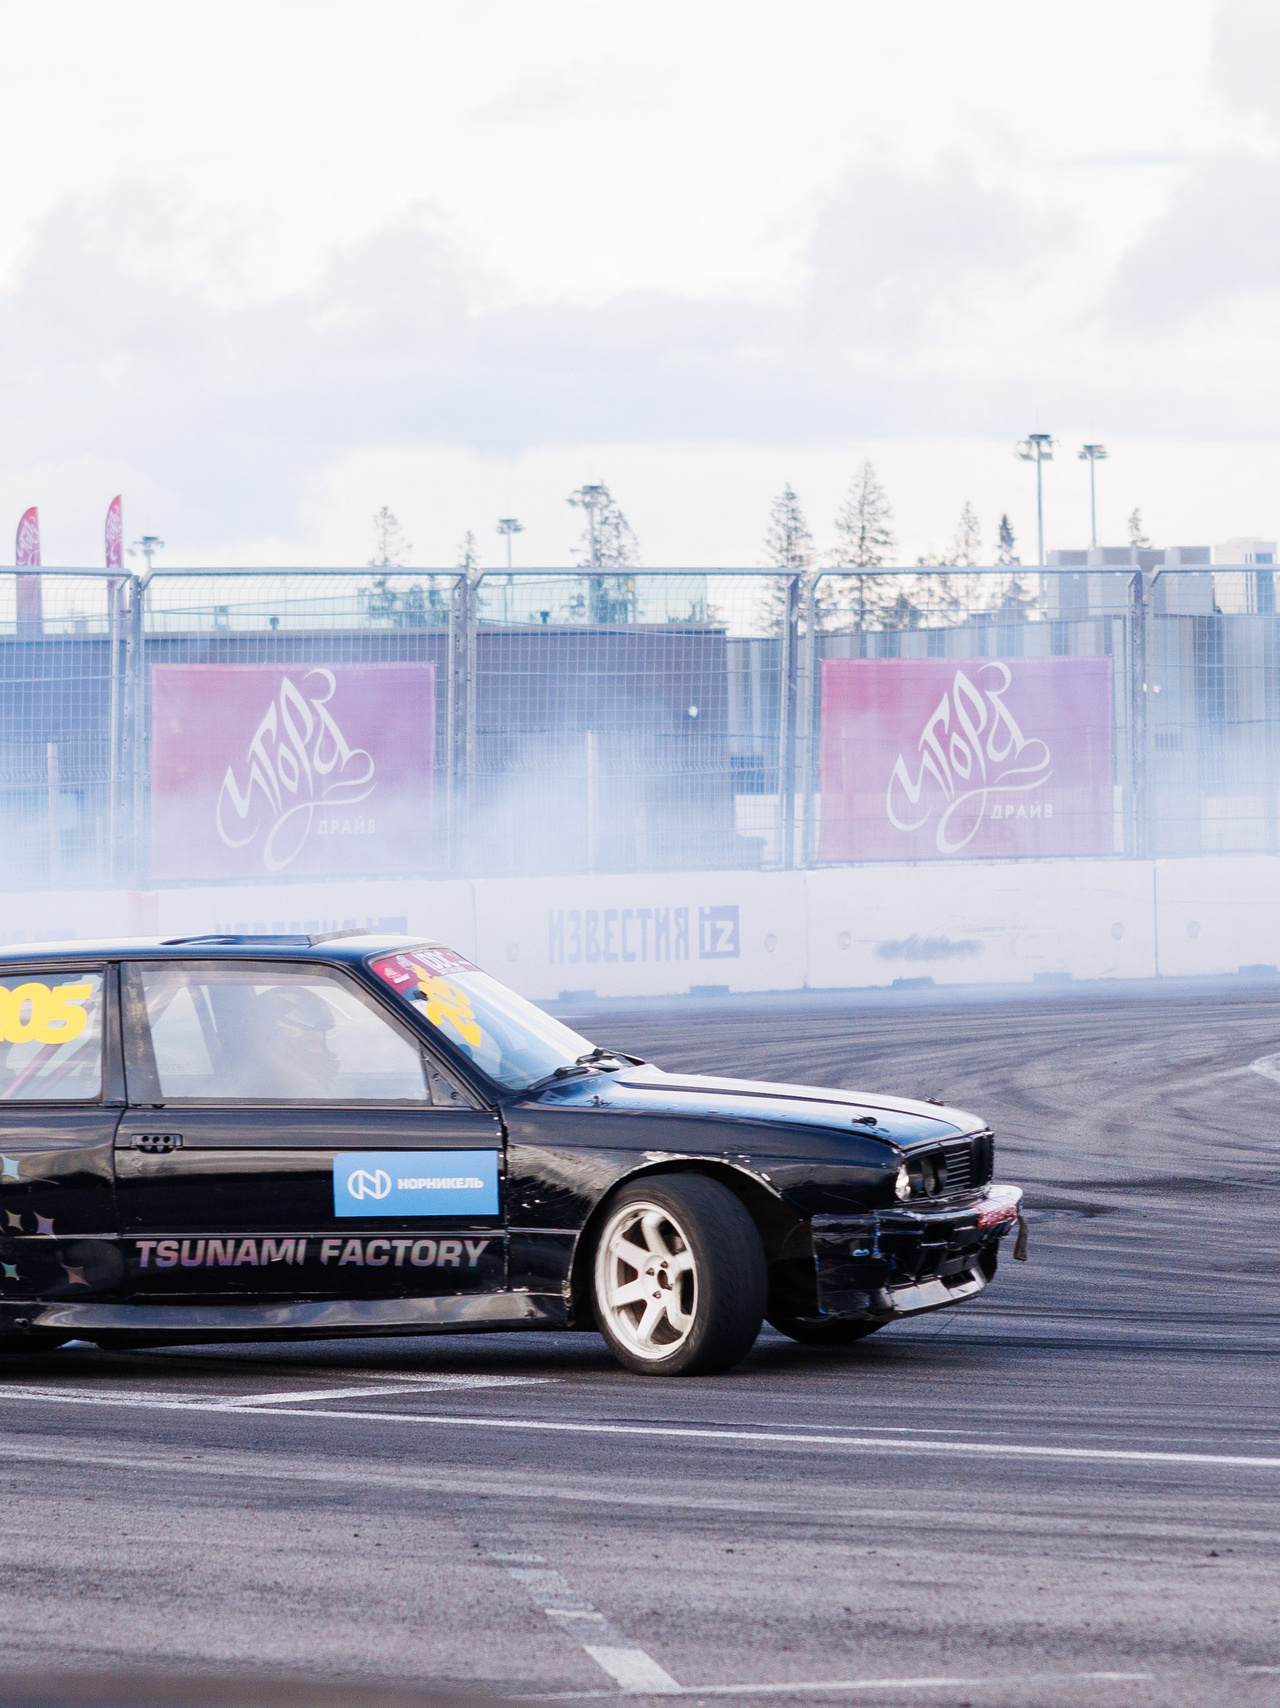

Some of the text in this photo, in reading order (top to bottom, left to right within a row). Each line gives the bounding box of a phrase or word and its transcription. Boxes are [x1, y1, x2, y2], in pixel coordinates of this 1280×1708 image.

[990, 801, 1054, 819] ДРАЙВ
[317, 815, 377, 836] ДРАЙВ
[547, 907, 690, 964] ИЗВЕСТИЯ
[397, 1177, 485, 1190] НОРНИКЕЛЬ
[136, 1239, 490, 1267] TSUNAMI FACTORY
